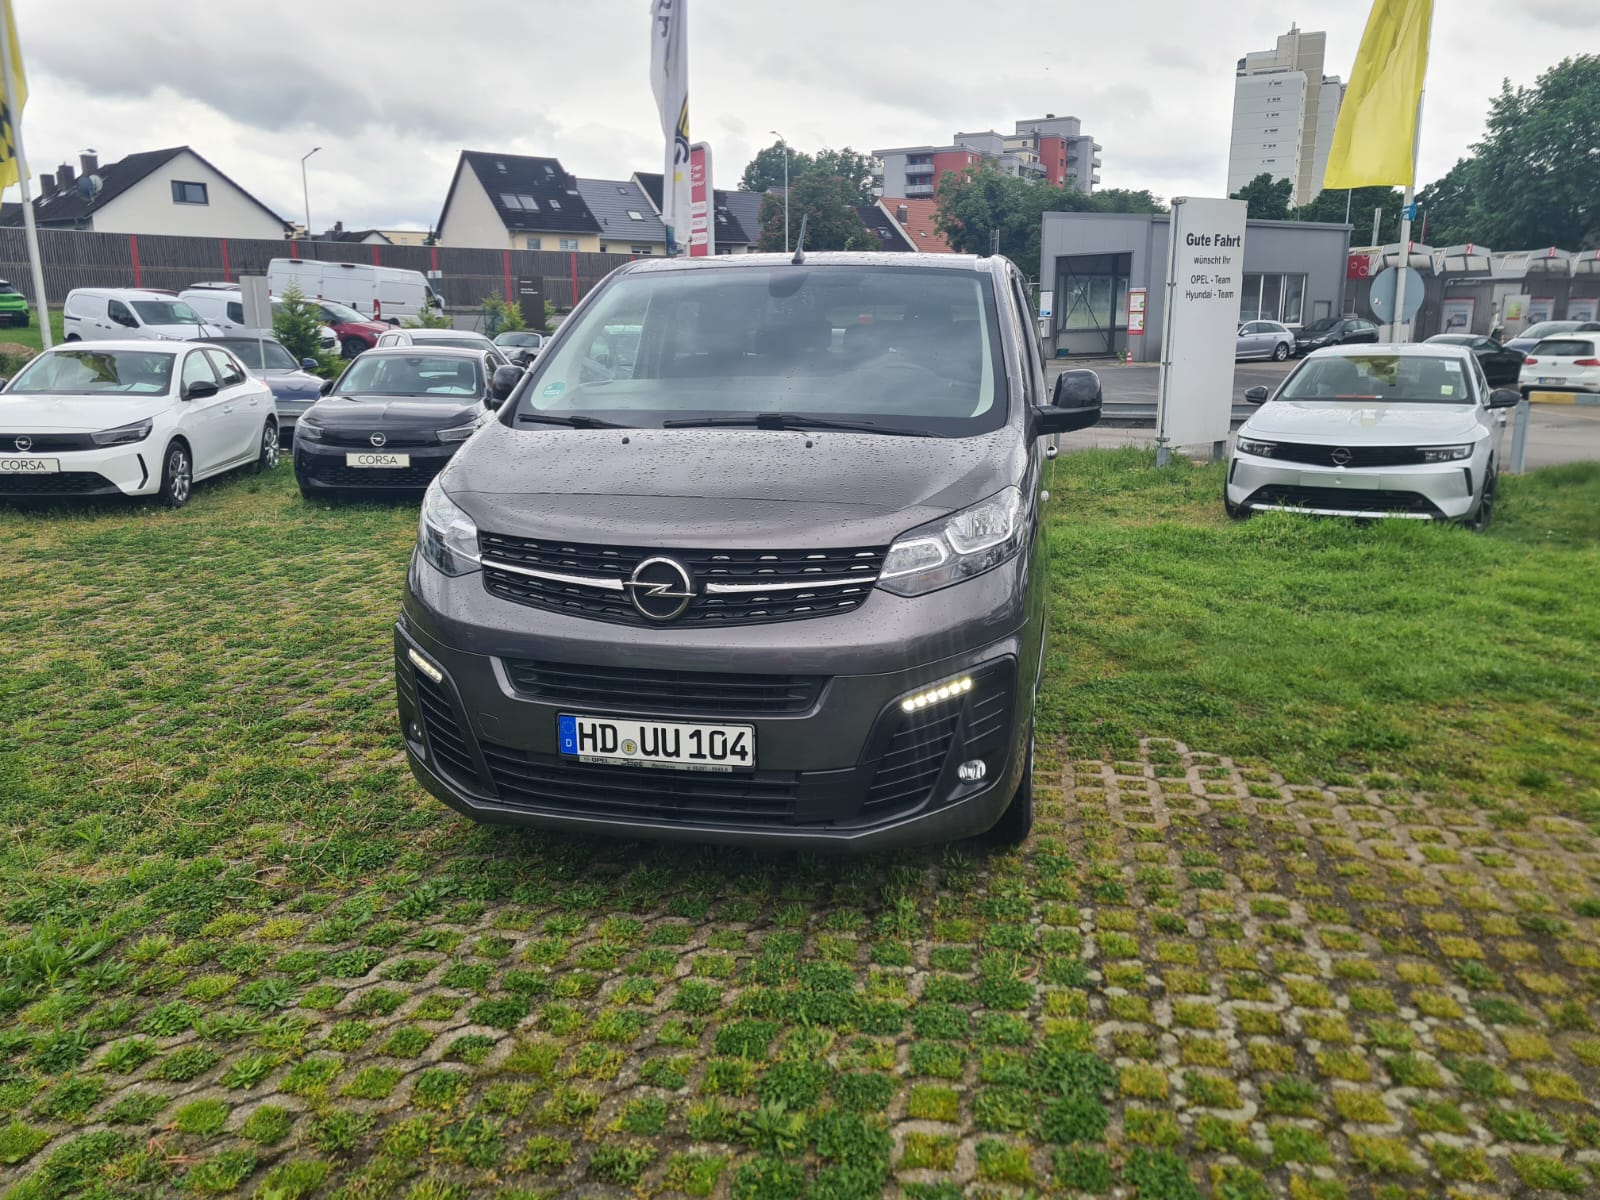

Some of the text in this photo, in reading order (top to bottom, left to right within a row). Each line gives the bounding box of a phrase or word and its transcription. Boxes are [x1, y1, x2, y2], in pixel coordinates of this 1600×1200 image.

[1186, 232, 1240, 247] Gute Fahrt
[1194, 255, 1231, 265] wünscht Ihr
[1190, 274, 1208, 284] OPEL
[1215, 275, 1230, 284] Team
[1186, 290, 1212, 301] Hyundai
[1218, 290, 1234, 298] Team
[1, 460, 46, 471] CORSA
[358, 455, 398, 465] CORSA
[578, 722, 748, 761] HD UU 104
